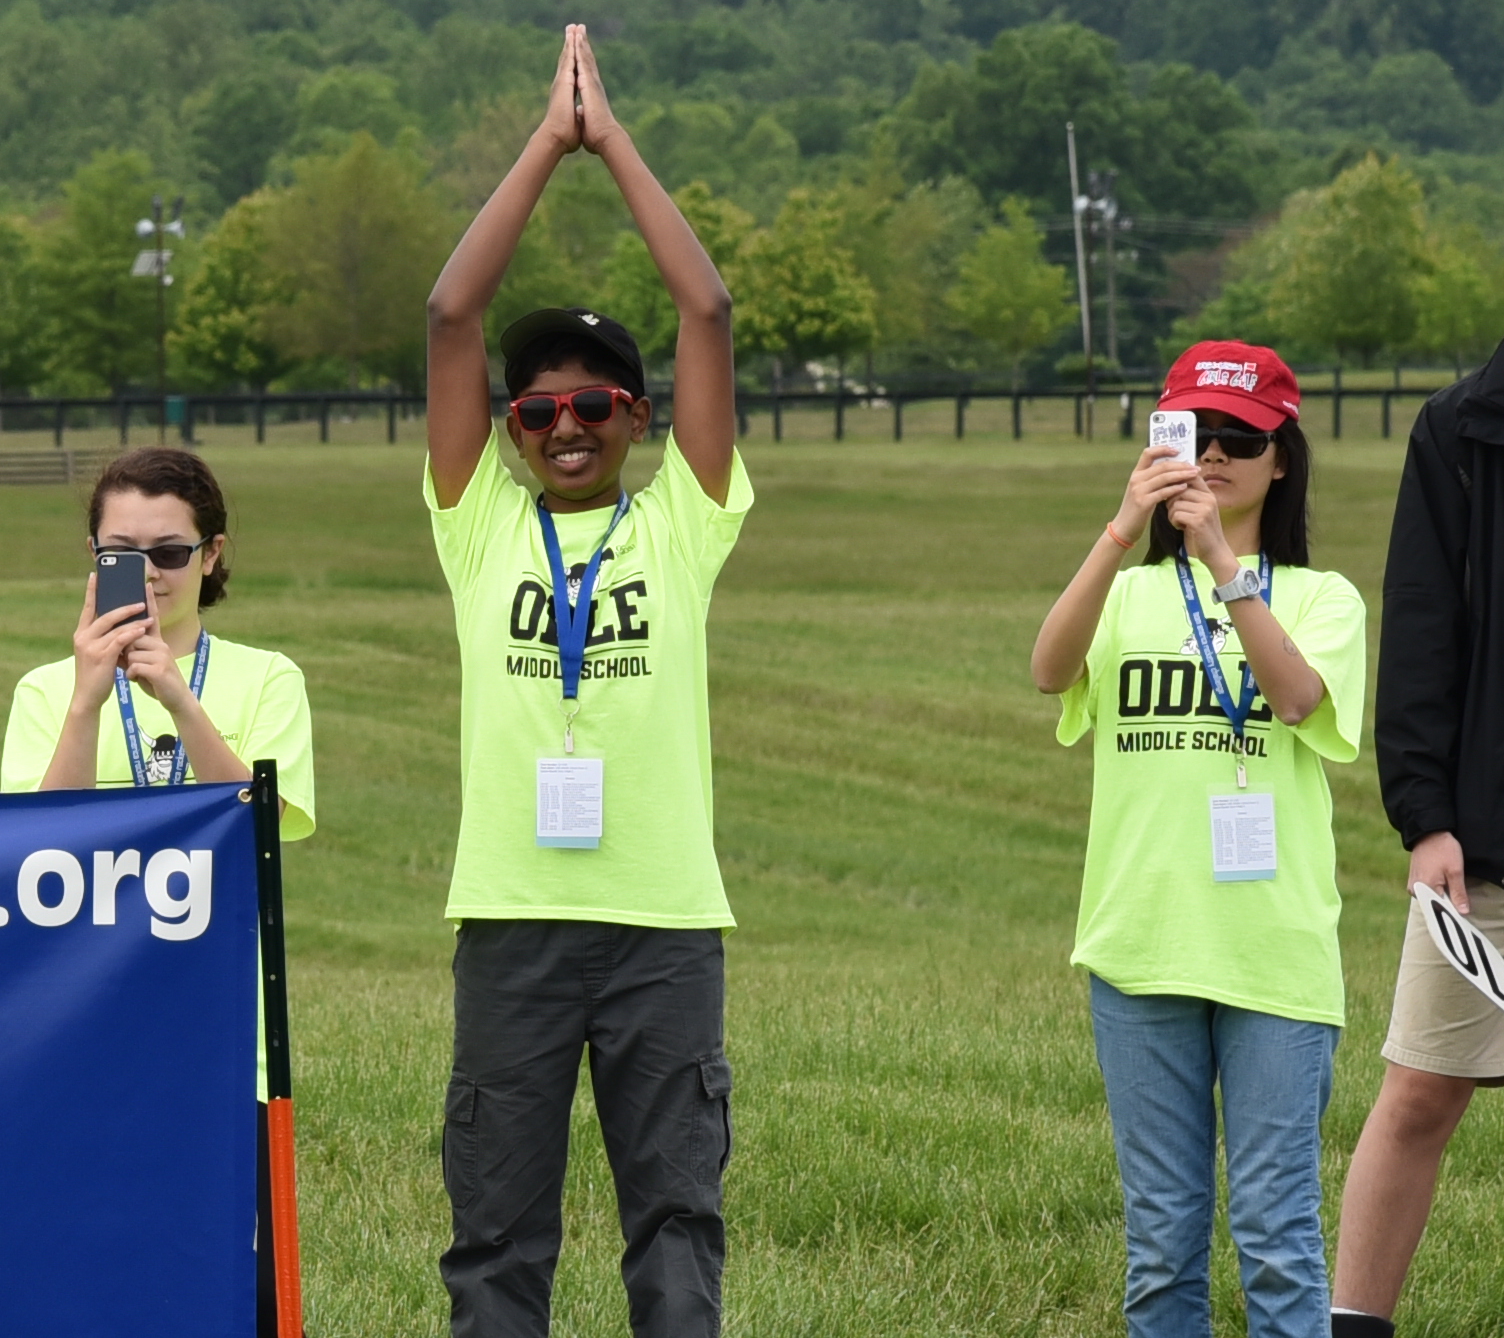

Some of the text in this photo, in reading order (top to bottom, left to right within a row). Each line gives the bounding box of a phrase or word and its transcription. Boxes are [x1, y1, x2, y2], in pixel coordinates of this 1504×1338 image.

[507, 655, 652, 679] MIDDL SCHOOL
[1117, 731, 1187, 752] MIDDLE
